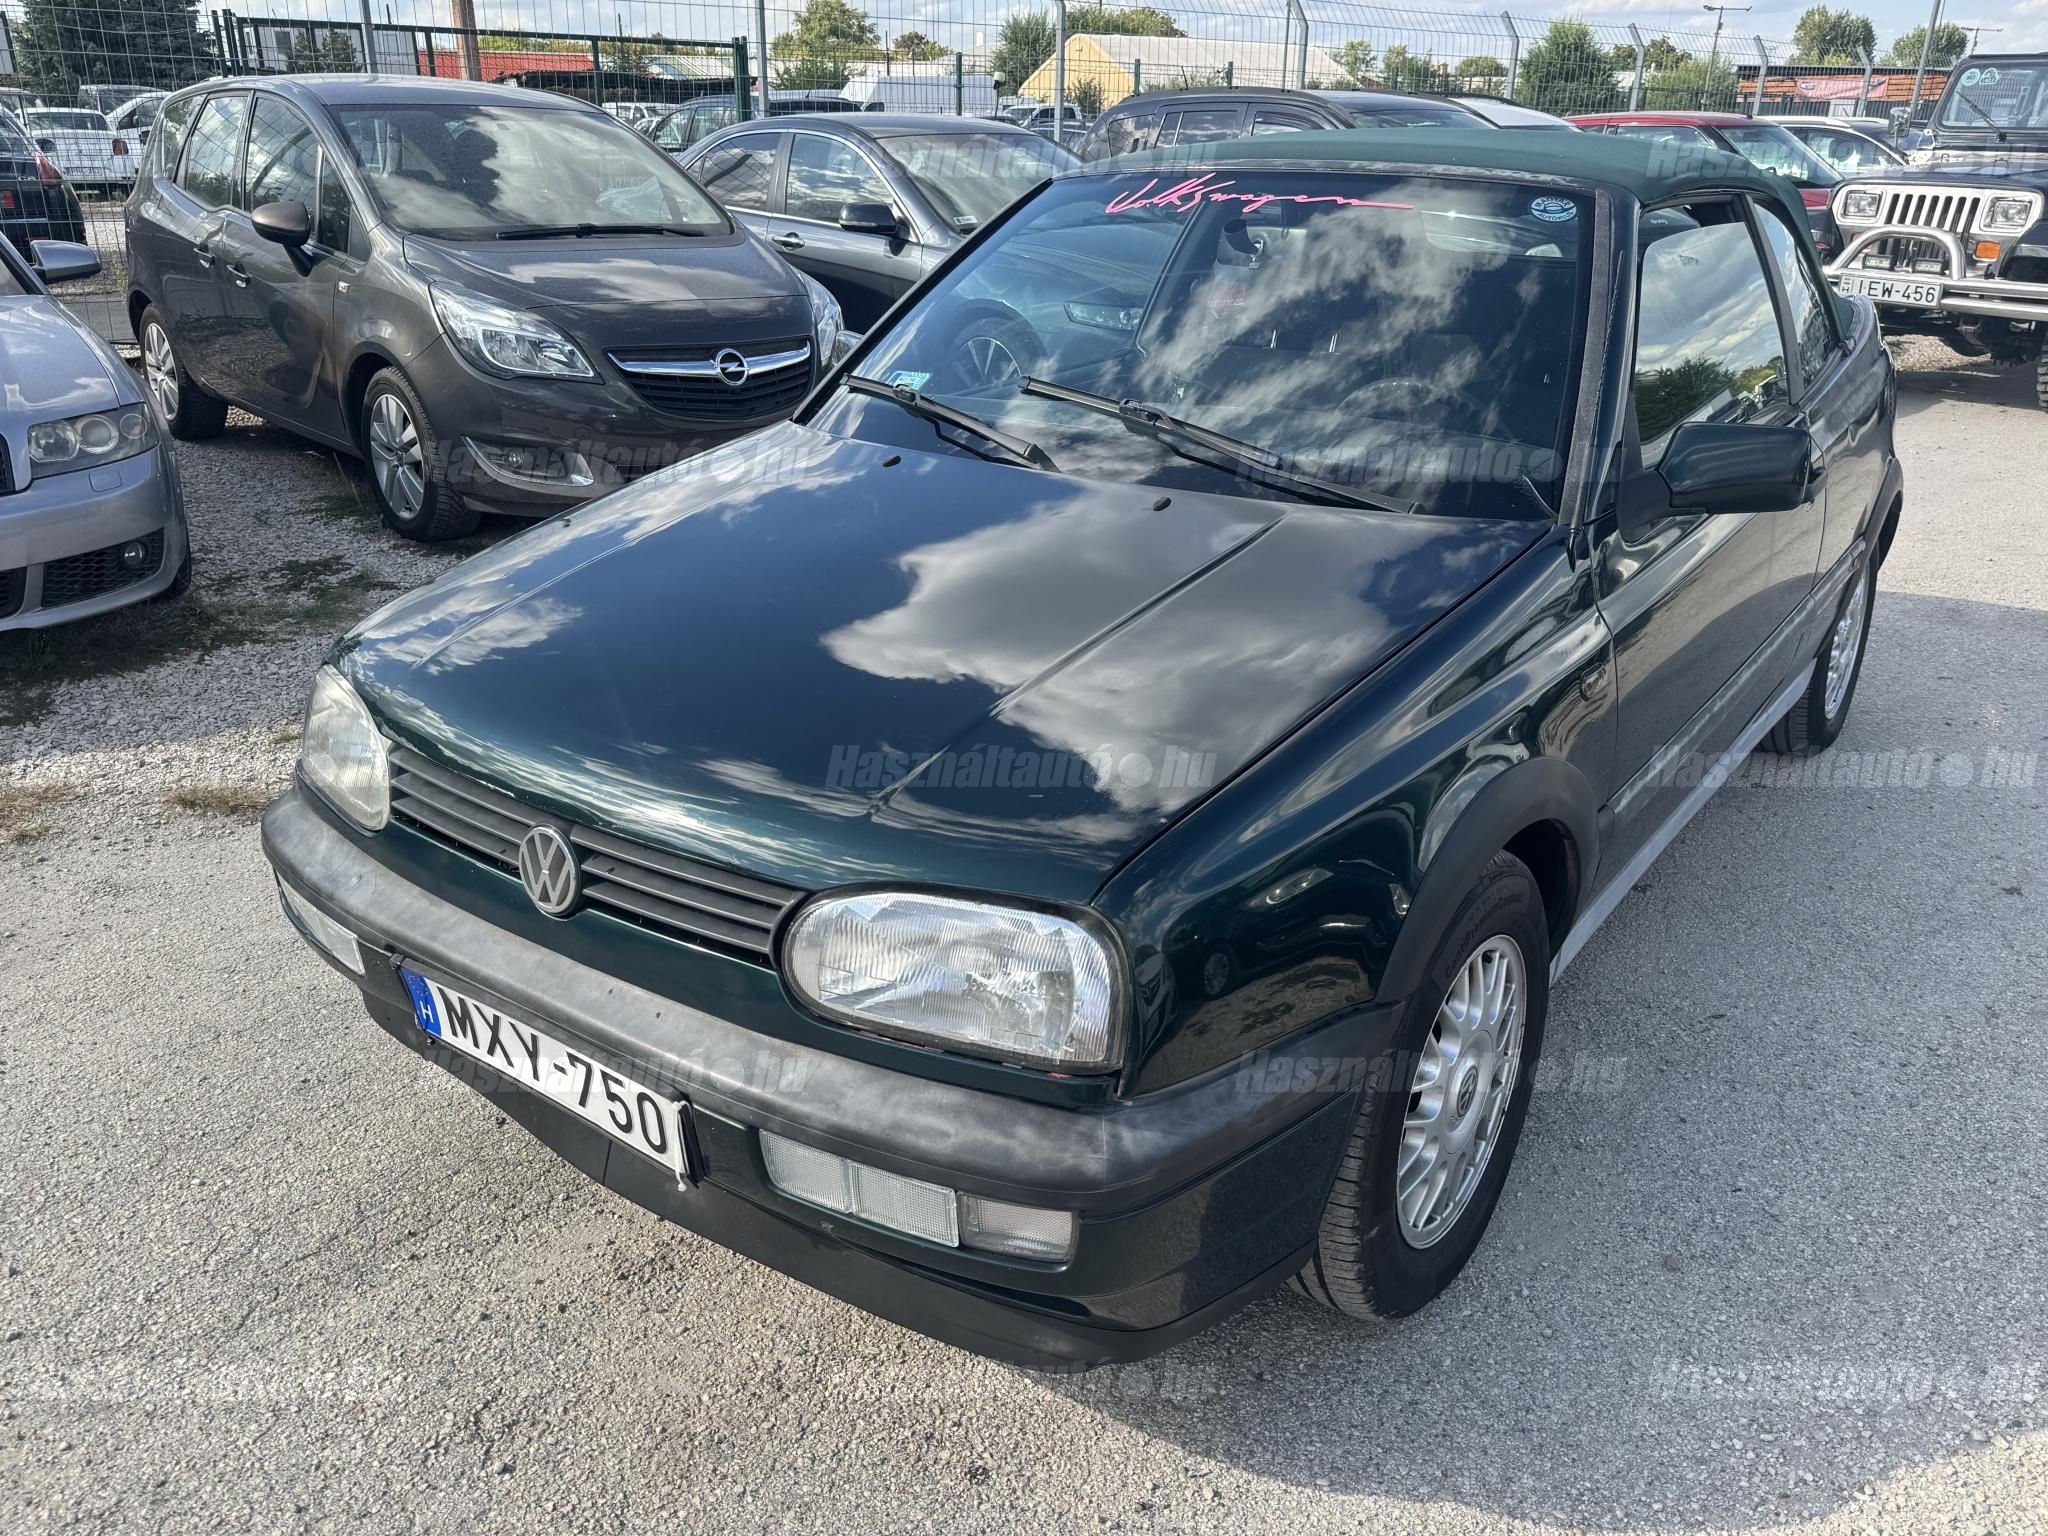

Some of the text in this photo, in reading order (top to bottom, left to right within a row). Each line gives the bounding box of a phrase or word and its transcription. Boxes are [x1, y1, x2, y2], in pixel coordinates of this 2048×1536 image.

[1105, 172, 1414, 214] Volkswagen
[1858, 279, 1936, 303] IEW-456
[418, 985, 667, 1155] H MXY-750
